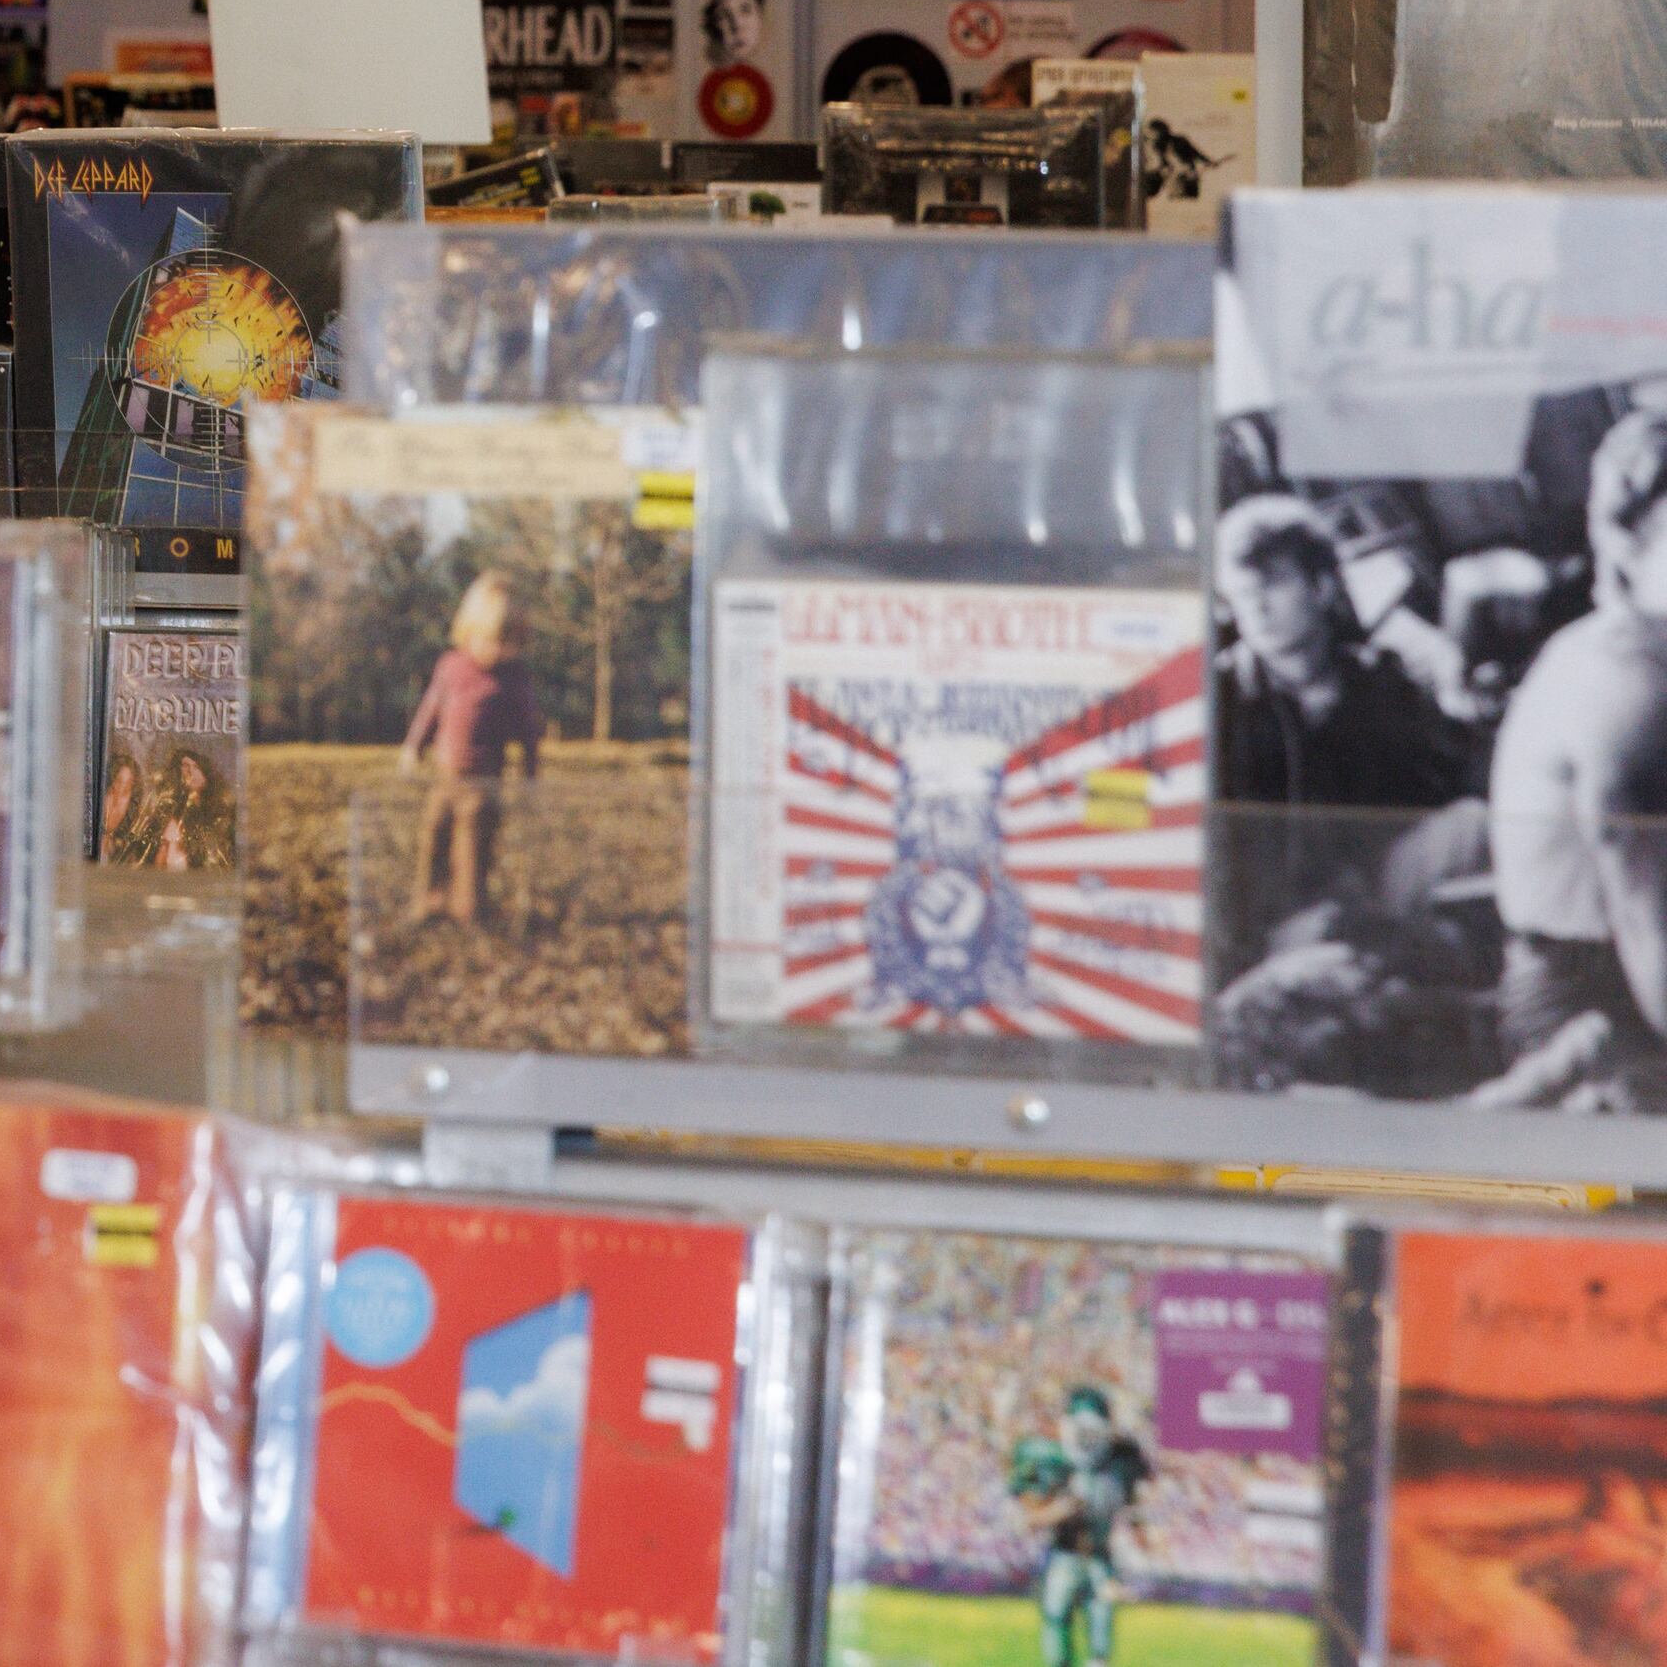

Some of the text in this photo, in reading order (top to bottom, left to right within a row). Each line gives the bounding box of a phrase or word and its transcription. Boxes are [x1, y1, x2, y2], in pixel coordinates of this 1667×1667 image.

[33, 156, 155, 210] DEF LEPPARD
[1315, 238, 1543, 354] a-ha
[124, 642, 206, 680] DEEP
[114, 695, 241, 734] MACHINE
